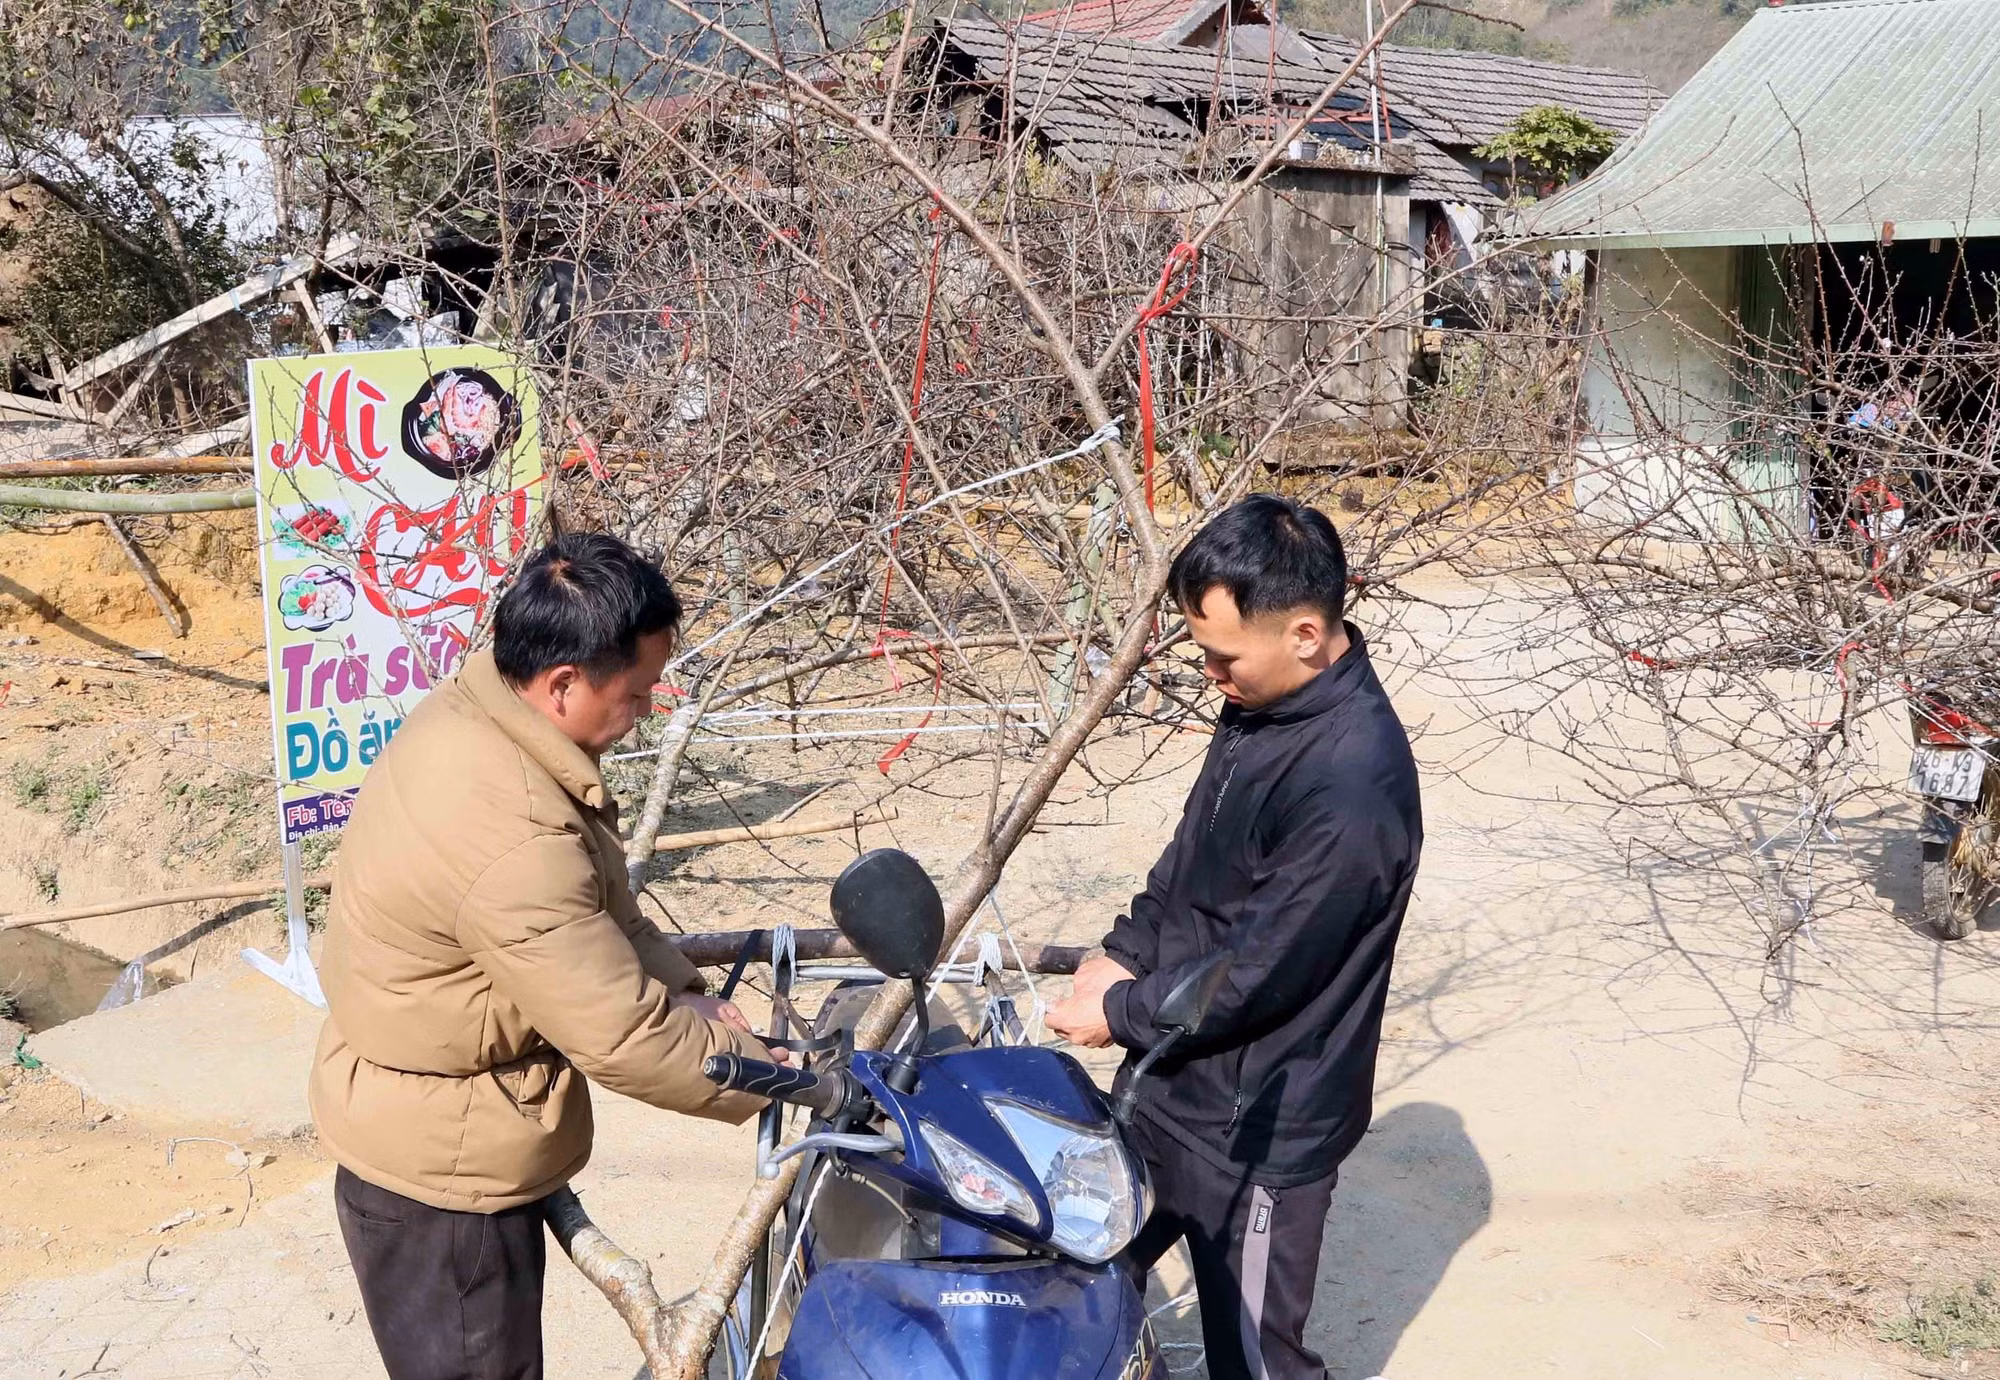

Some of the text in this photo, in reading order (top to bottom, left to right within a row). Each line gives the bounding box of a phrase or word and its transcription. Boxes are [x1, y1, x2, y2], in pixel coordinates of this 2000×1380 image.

[270, 369, 388, 484] Mì
[282, 633, 370, 713] Trà
[286, 707, 349, 780] Đồ
[287, 804, 318, 828] Fb:
[940, 1290, 1027, 1307] HONDA
